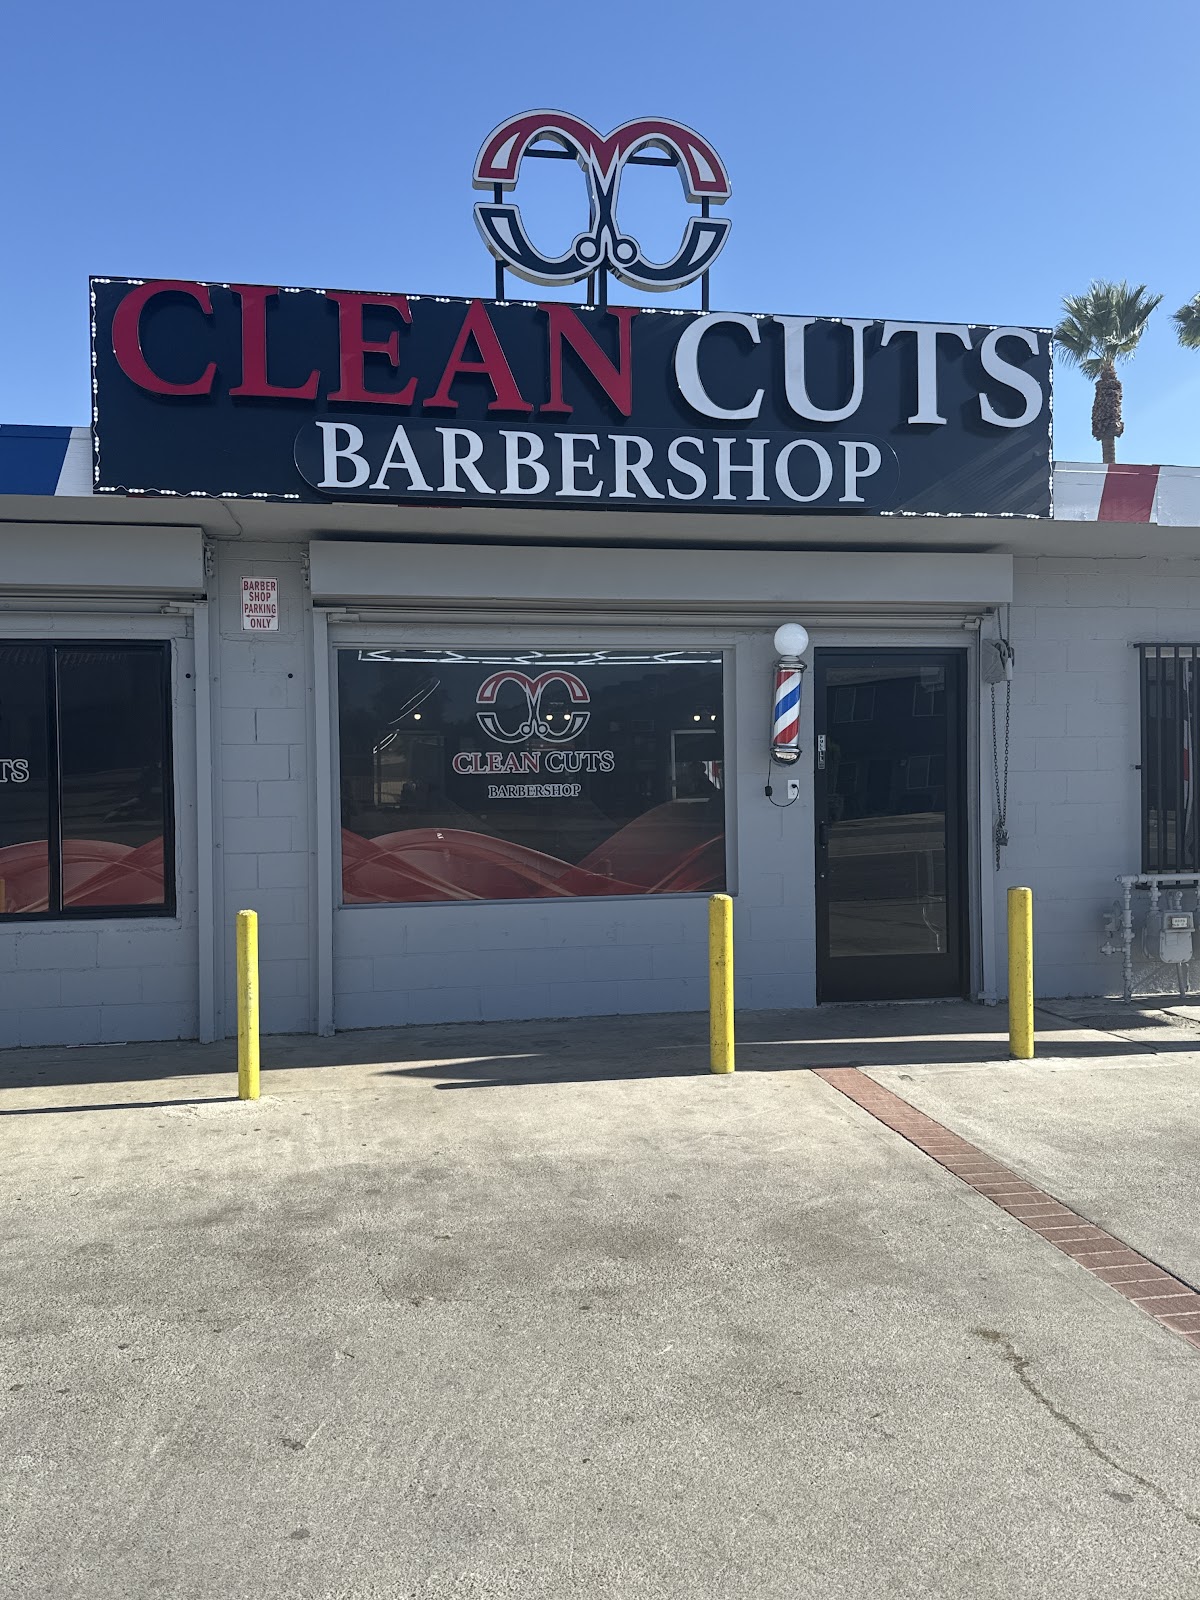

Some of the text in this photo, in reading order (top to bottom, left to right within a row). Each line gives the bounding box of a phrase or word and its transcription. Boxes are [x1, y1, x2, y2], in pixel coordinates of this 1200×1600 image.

[111, 280, 1043, 429] CLEAN CUTS
[315, 421, 882, 503] BARBERSHOP
[243, 581, 276, 591] BARBER
[249, 592, 271, 601] SHOP
[244, 604, 276, 613] PARKING
[250, 618, 271, 628] ONLY
[452, 751, 615, 775] CLEAN CUTS
[488, 784, 581, 798] BARBERSHOP
